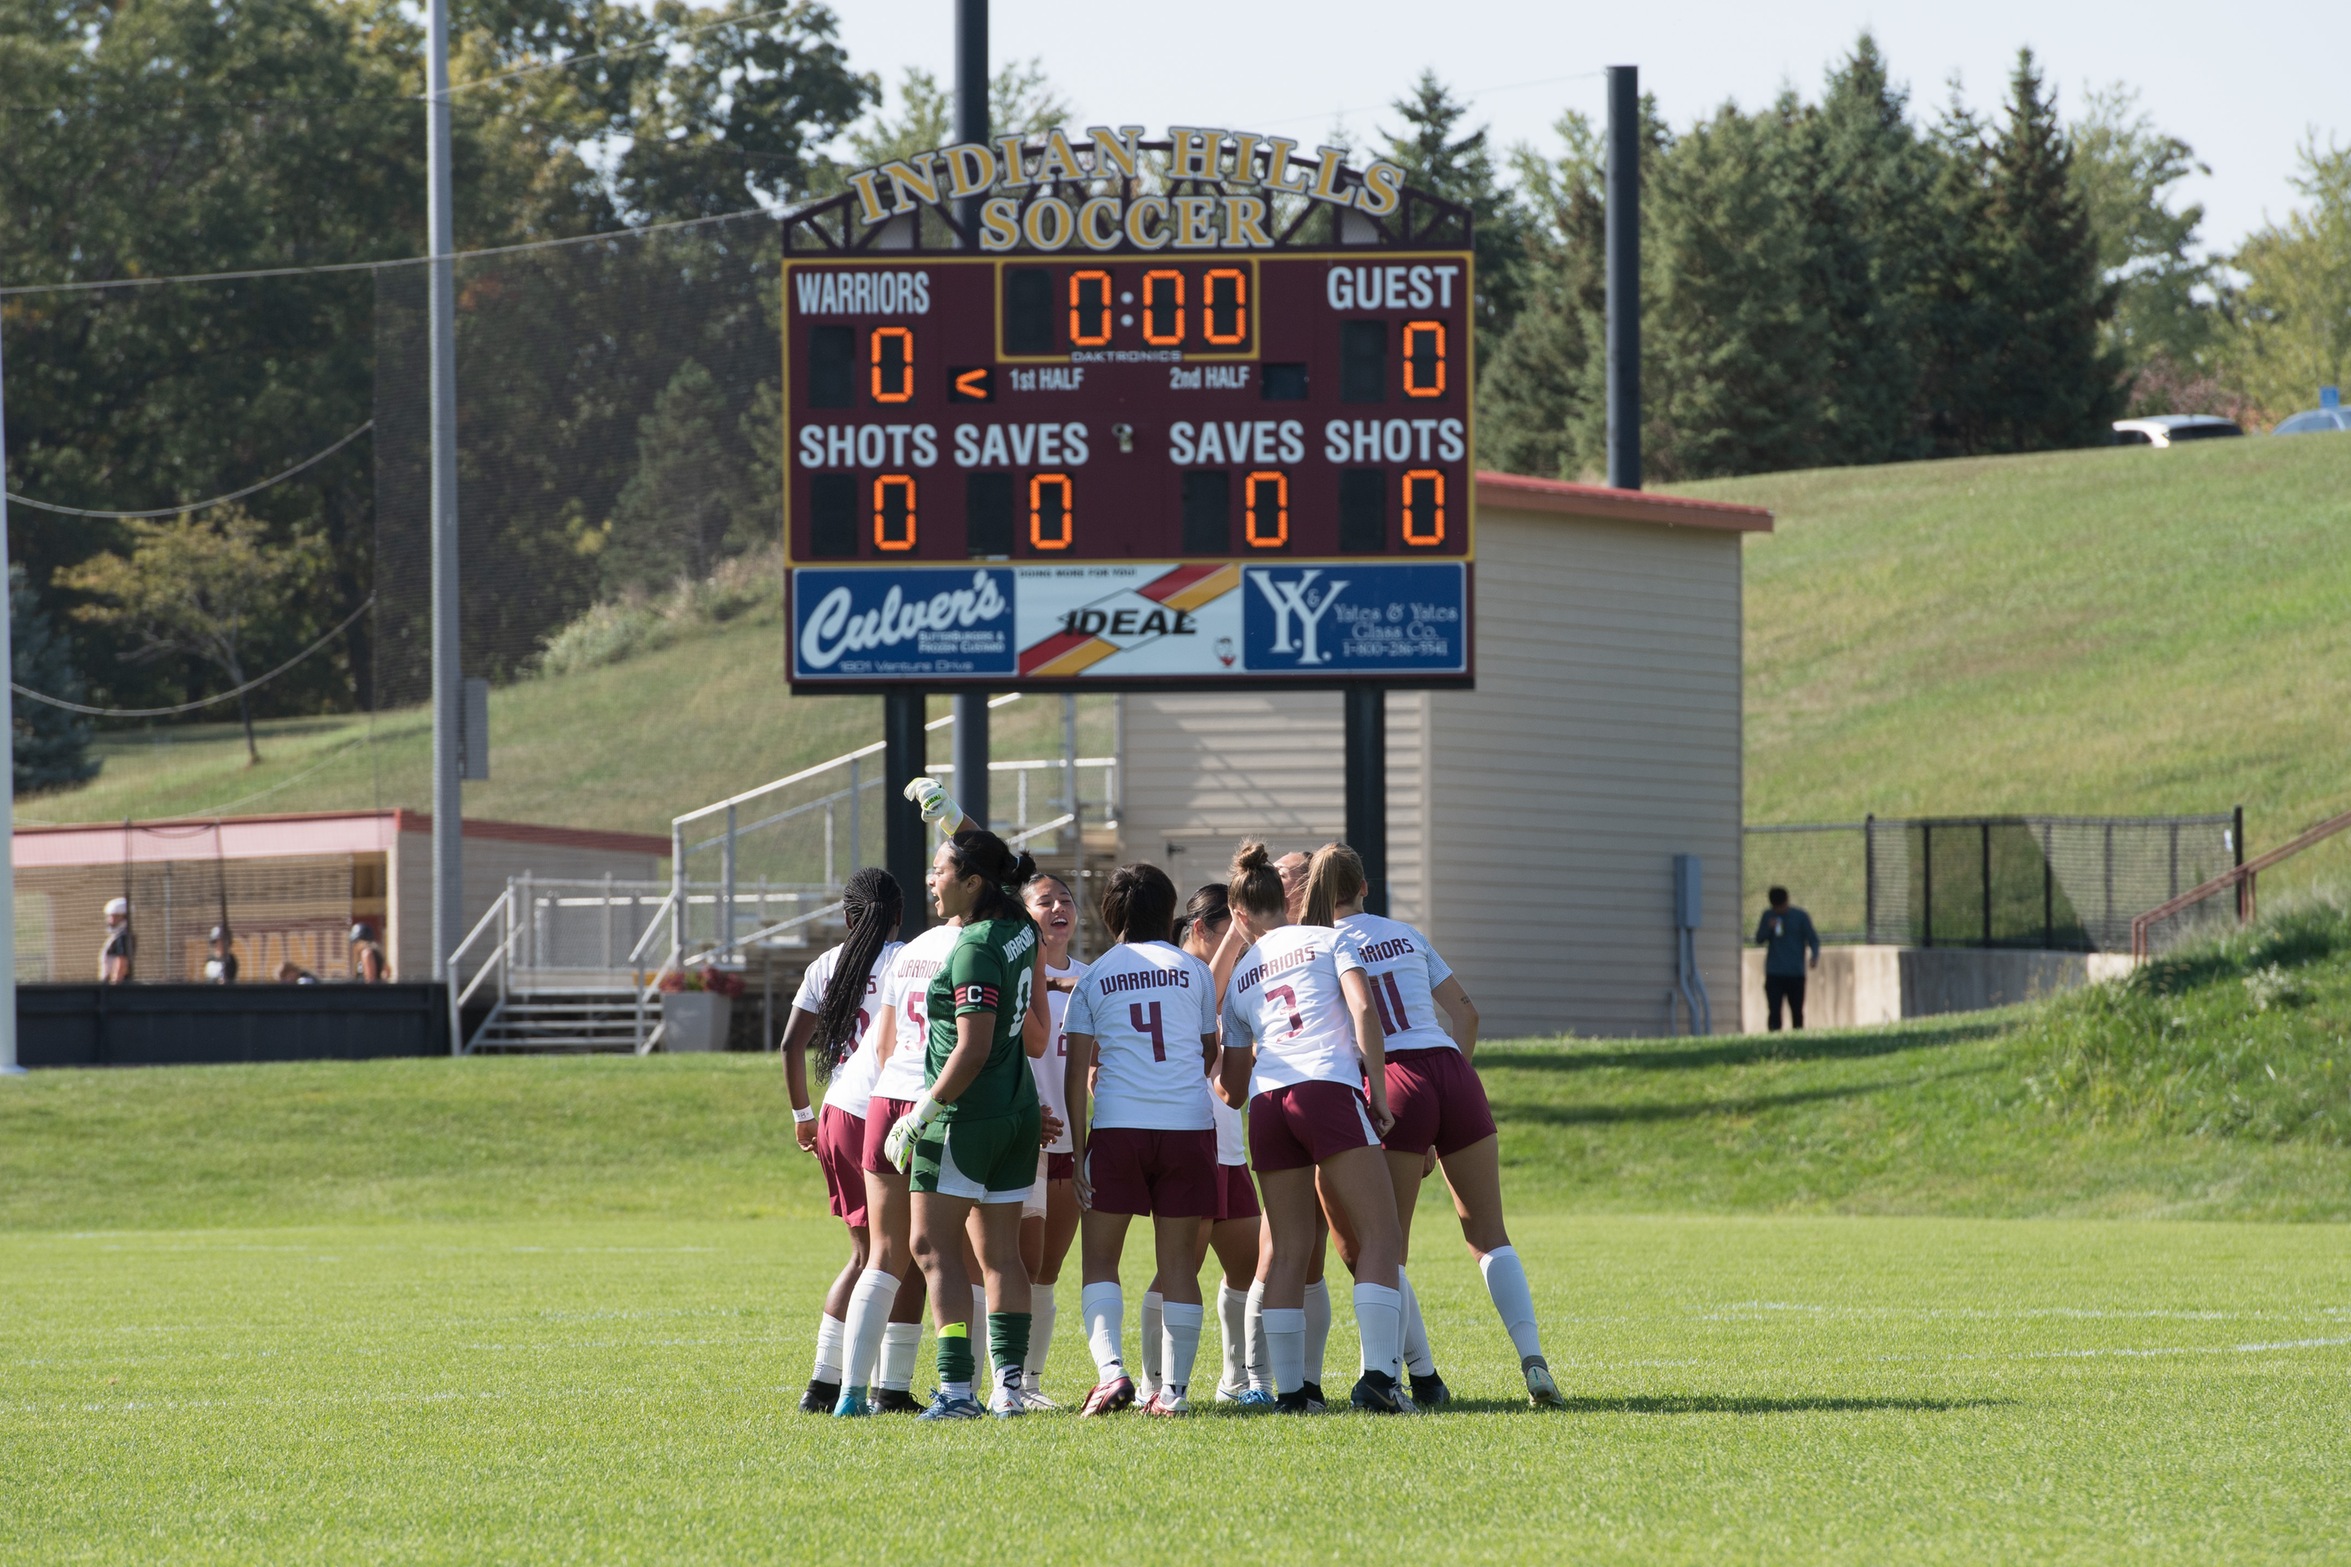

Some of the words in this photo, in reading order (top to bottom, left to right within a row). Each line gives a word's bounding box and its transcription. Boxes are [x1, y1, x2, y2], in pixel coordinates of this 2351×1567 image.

[847, 126, 1145, 226] INDIAN
[1168, 126, 1406, 216] HILLS
[980, 195, 1274, 251] SOCCER
[796, 271, 931, 315] WARRIORS
[1069, 269, 1246, 346] 0:00
[1326, 265, 1459, 310] GUEST
[871, 327, 914, 403] 0
[1009, 368, 1037, 391] 1st
[1039, 367, 1084, 390] HALF
[1071, 351, 1183, 363] DAKTRONICS
[1169, 366, 1202, 390] 2nd
[1205, 366, 1250, 389] HALF
[1403, 320, 1446, 397] 0
[799, 425, 938, 467] SHOTS
[954, 422, 1090, 466] SAVES
[1169, 420, 1304, 464] SAVES
[1325, 418, 1464, 462] SHOTS
[874, 474, 917, 551] 0
[1030, 473, 1073, 550] 0
[1245, 471, 1288, 547] 0
[1402, 469, 1445, 546] 0
[800, 568, 1006, 669] Culver's
[1062, 608, 1197, 635] IDEAL
[1352, 621, 1402, 639] Glass
[1386, 602, 1404, 622] &
[874, 660, 932, 672] Venture
[935, 659, 974, 672] Drive
[1237, 945, 1316, 994] WARRIORS
[1357, 937, 1415, 963] RRIORS
[967, 985, 983, 1003] C
[1100, 969, 1190, 996] WARRIORS
[1369, 971, 1412, 1037] 11
[904, 991, 927, 1051] 5
[1129, 1001, 1166, 1062] 4
